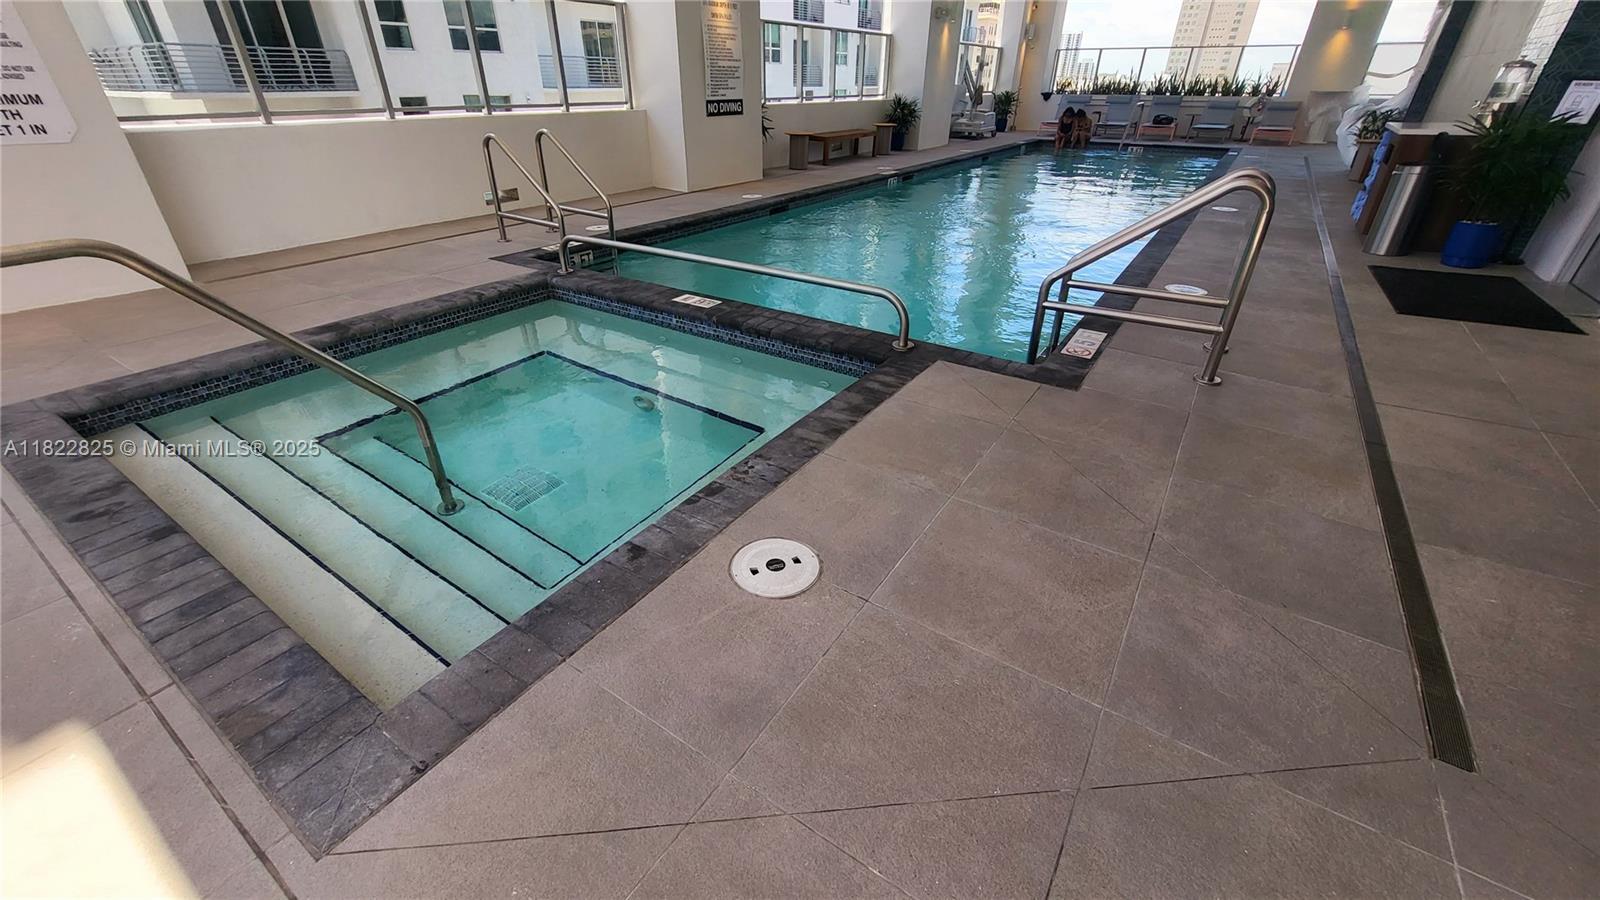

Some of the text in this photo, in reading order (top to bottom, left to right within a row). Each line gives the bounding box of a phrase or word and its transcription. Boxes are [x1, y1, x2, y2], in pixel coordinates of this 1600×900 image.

[707, 102, 741, 113] NO DIVING
[17, 125, 26, 135] 1
[29, 124, 47, 135] IN
[580, 252, 592, 263] FT
